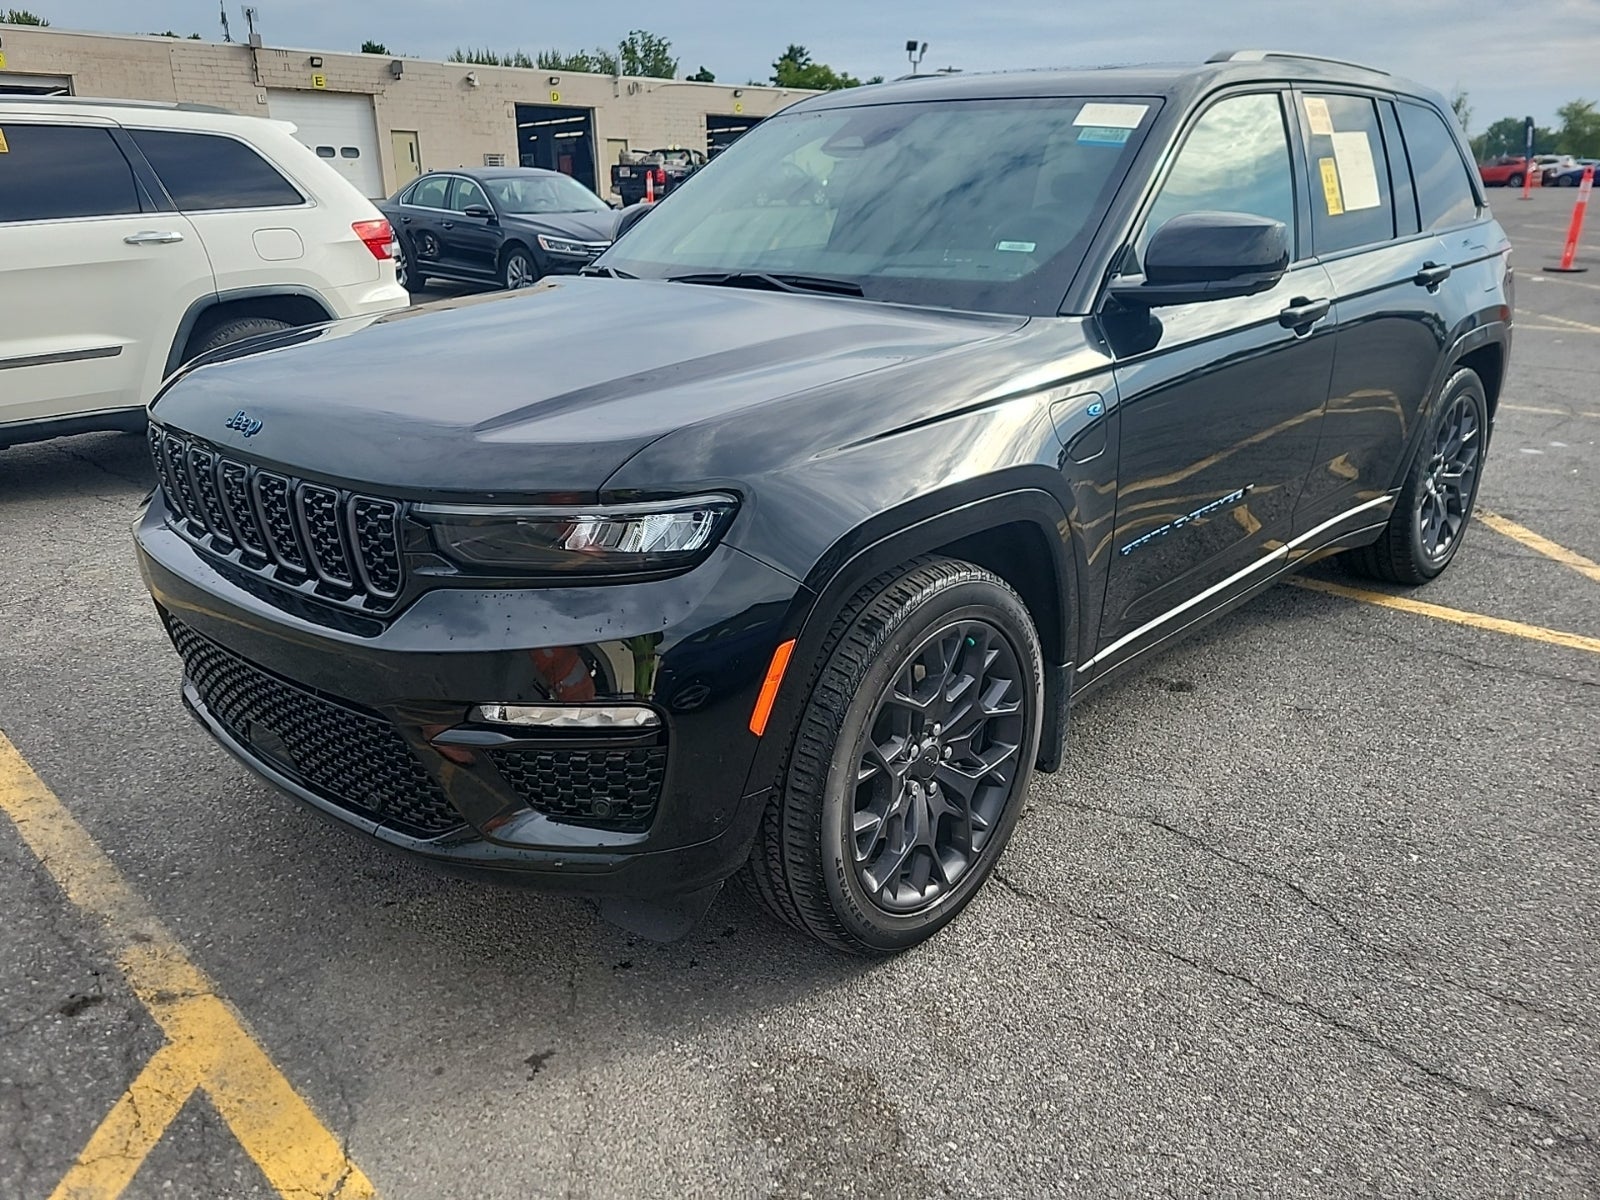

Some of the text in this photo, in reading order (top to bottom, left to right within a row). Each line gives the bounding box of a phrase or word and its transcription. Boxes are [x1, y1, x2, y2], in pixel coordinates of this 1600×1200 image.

[315, 76, 324, 87] E
[552, 92, 559, 102] D
[225, 410, 263, 438] Jeep
